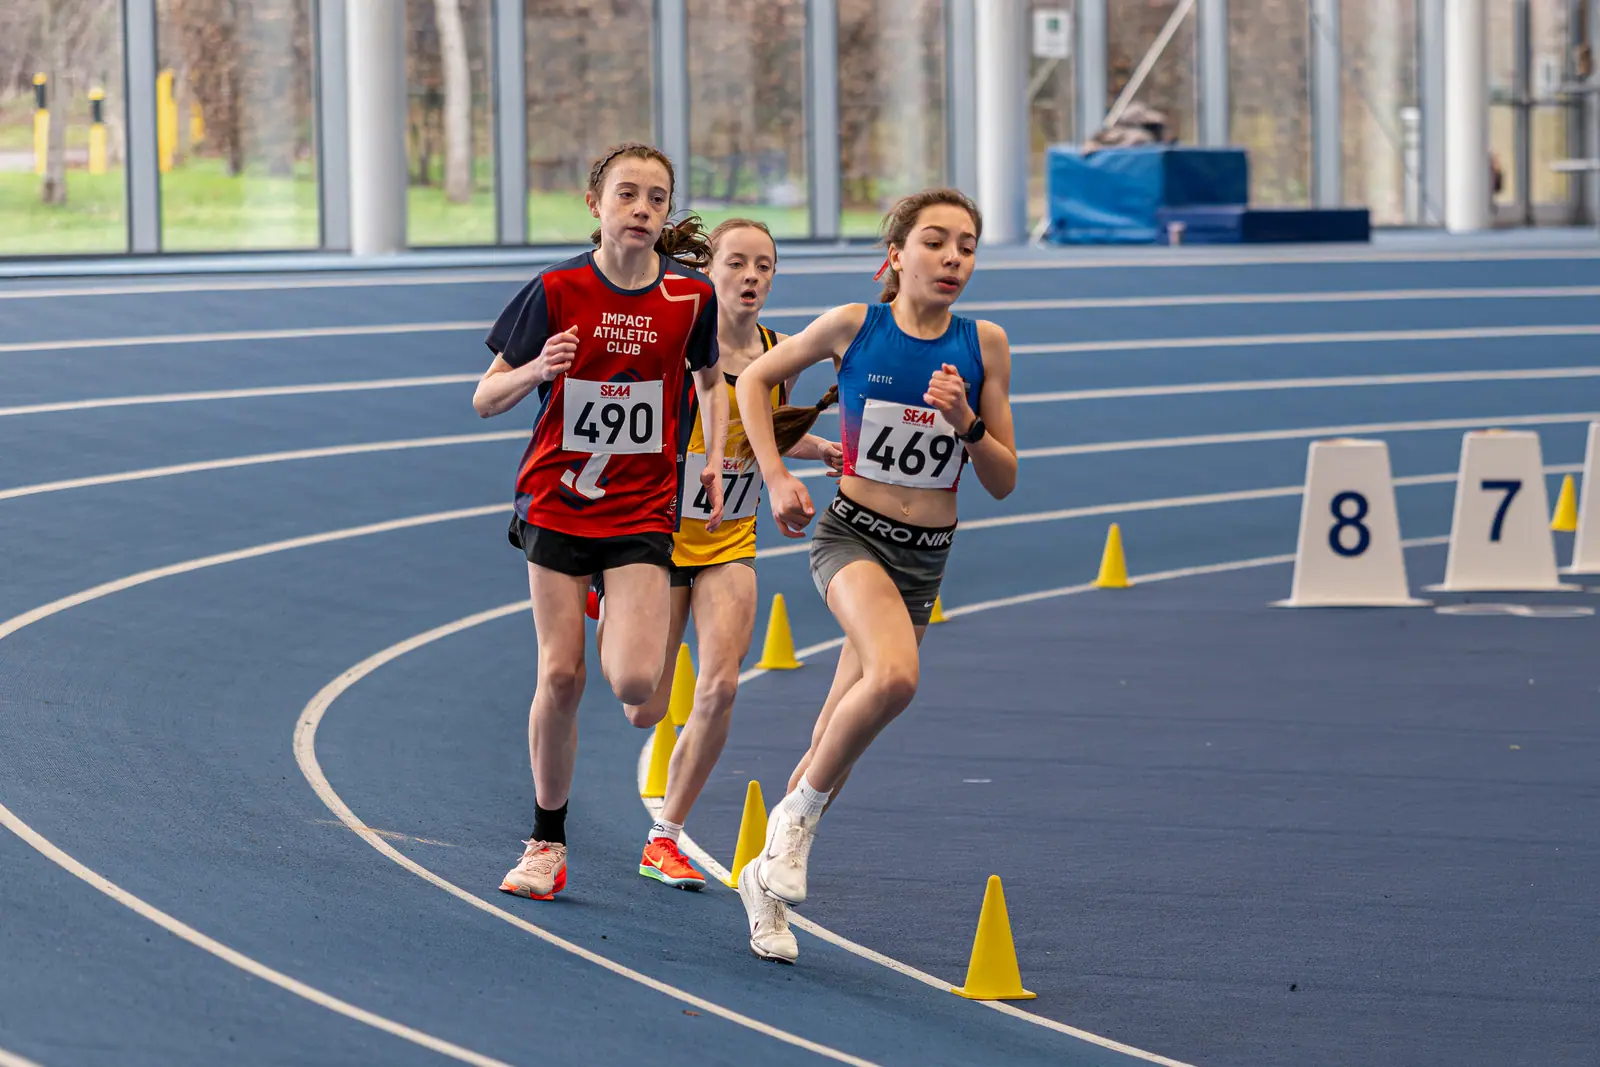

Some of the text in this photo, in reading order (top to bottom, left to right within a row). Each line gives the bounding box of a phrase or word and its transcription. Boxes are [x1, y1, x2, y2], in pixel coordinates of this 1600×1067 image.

[601, 312, 653, 329] IMPACT
[593, 326, 658, 344] ATHLETIC
[606, 341, 641, 356] CLUB
[600, 384, 630, 397] SEAA
[867, 373, 893, 385] TACTIC
[573, 402, 654, 445] 490
[902, 408, 936, 426] SEAA
[866, 426, 955, 478] 469
[692, 472, 755, 514] 477
[1480, 480, 1522, 542] 7
[851, 511, 913, 542] PRO
[1328, 490, 1371, 558] 8
